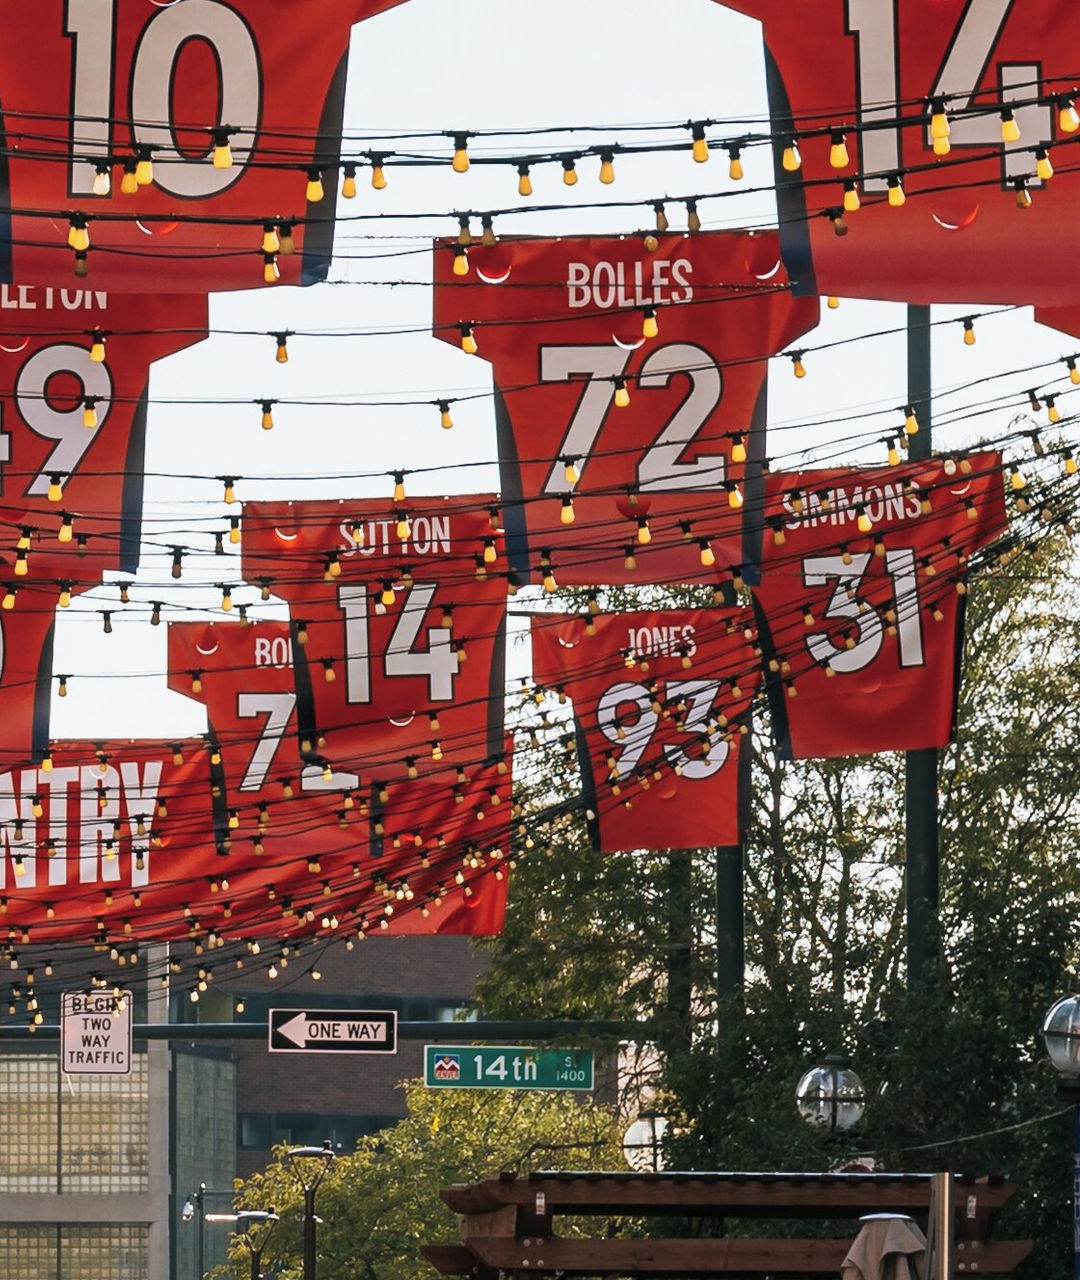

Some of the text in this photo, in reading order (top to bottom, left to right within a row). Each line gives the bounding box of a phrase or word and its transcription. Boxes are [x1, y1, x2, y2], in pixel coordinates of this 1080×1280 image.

[566, 258, 694, 308] BOLLES
[538, 343, 726, 496] 72
[782, 481, 921, 530] SIMMONS
[339, 517, 452, 557] SUTTON
[801, 548, 926, 674] 31
[337, 581, 462, 705] 14
[620, 624, 698, 658] JONES
[598, 680, 730, 780] 93
[81, 1034, 111, 1048] WAY
[82, 1018, 112, 1031] TWO
[308, 1022, 382, 1040] ONE WAY
[68, 1050, 125, 1065] TRAFFIC
[473, 1054, 538, 1081] 14th
[555, 1070, 586, 1081] 1400
